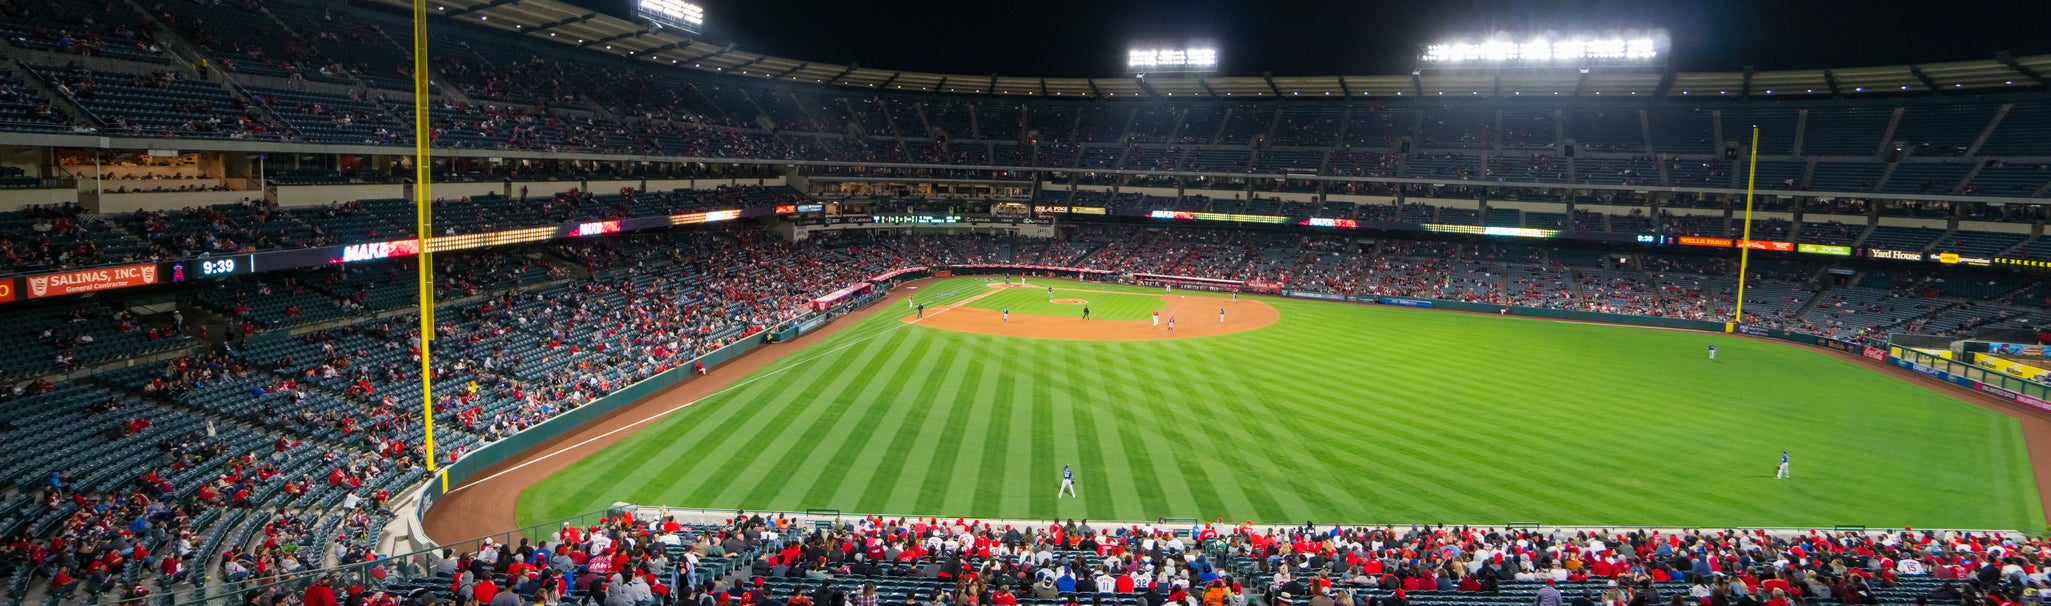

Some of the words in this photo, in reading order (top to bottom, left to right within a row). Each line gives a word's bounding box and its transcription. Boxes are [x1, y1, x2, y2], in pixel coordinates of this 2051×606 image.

[1680, 237, 1705, 245] WELLS
[1706, 238, 1731, 246] FARGO
[343, 242, 388, 262] MAKE
[1871, 248, 1891, 258] Yard
[1893, 250, 1921, 261] House
[202, 259, 234, 275] 9:39
[50, 270, 111, 287] SALINAS,
[114, 267, 141, 280] INC.
[65, 282, 93, 293] General
[94, 280, 129, 291] Contractor
[1906, 564, 1917, 572] 15
[1136, 578, 1147, 587] 32
